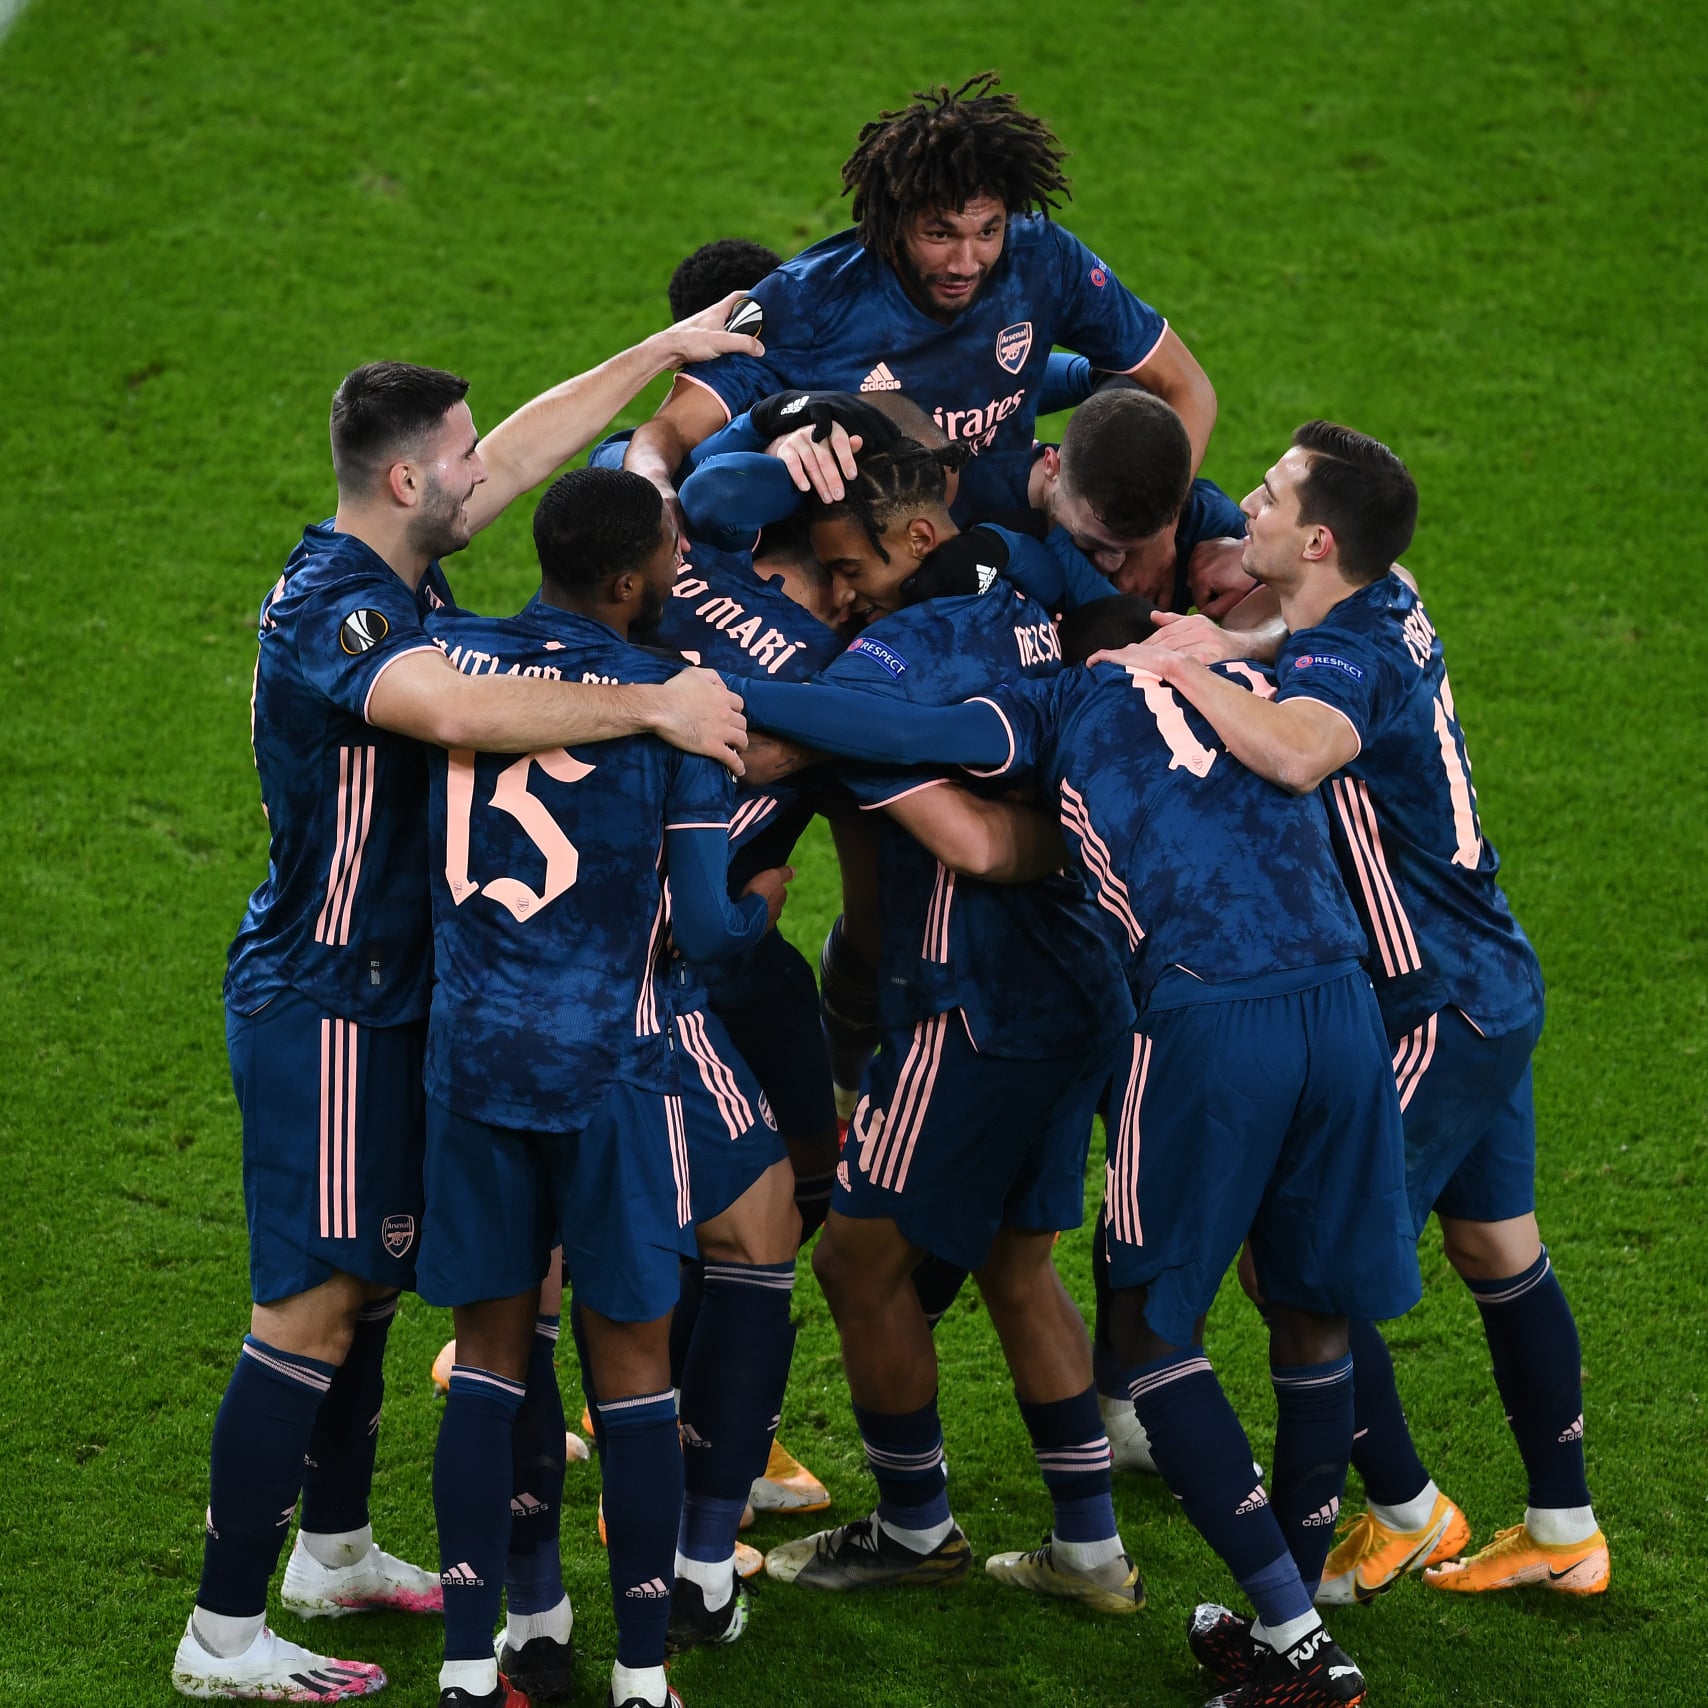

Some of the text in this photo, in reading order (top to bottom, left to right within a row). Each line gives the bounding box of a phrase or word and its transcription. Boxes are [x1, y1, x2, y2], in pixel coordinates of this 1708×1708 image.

[1001, 328, 1027, 344] Arsenal
[860, 380, 902, 392] adidas
[932, 389, 1025, 441] irates
[860, 641, 906, 674] RESPECT
[1314, 656, 1363, 678] RESPECT
[445, 747, 597, 923] 15
[387, 1221, 409, 1230] Arsenal
[440, 1576, 485, 1586] adidas
